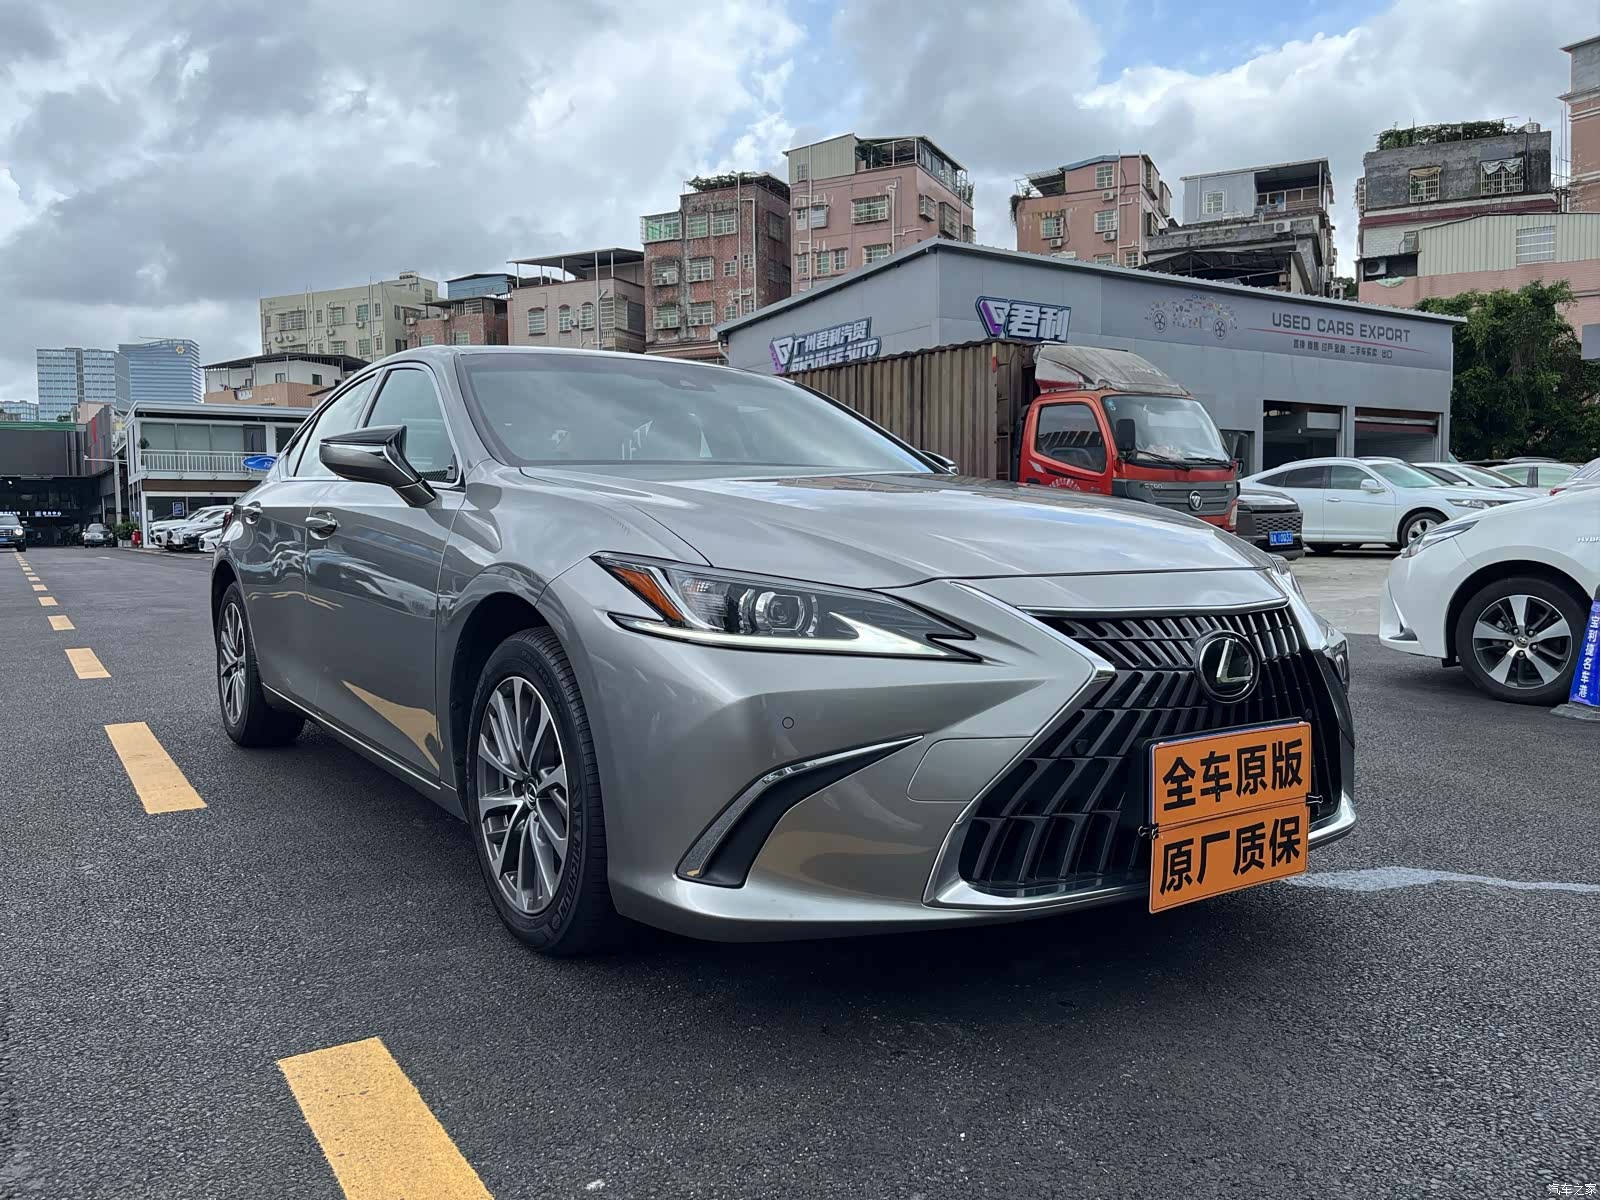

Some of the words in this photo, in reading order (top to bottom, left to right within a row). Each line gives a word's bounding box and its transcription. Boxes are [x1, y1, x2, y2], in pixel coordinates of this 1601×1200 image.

[794, 320, 868, 355] 广州君利汽贸
[1007, 303, 1070, 341] 君利
[1272, 311, 1311, 331] USED
[1317, 317, 1355, 337] CARS
[1359, 323, 1411, 343] EXPORT
[845, 339, 879, 361] AUTO
[1162, 738, 1303, 811] 全车原版
[1159, 815, 1300, 895] 原厂质保
[559, 838, 580, 920] MICHELIN
